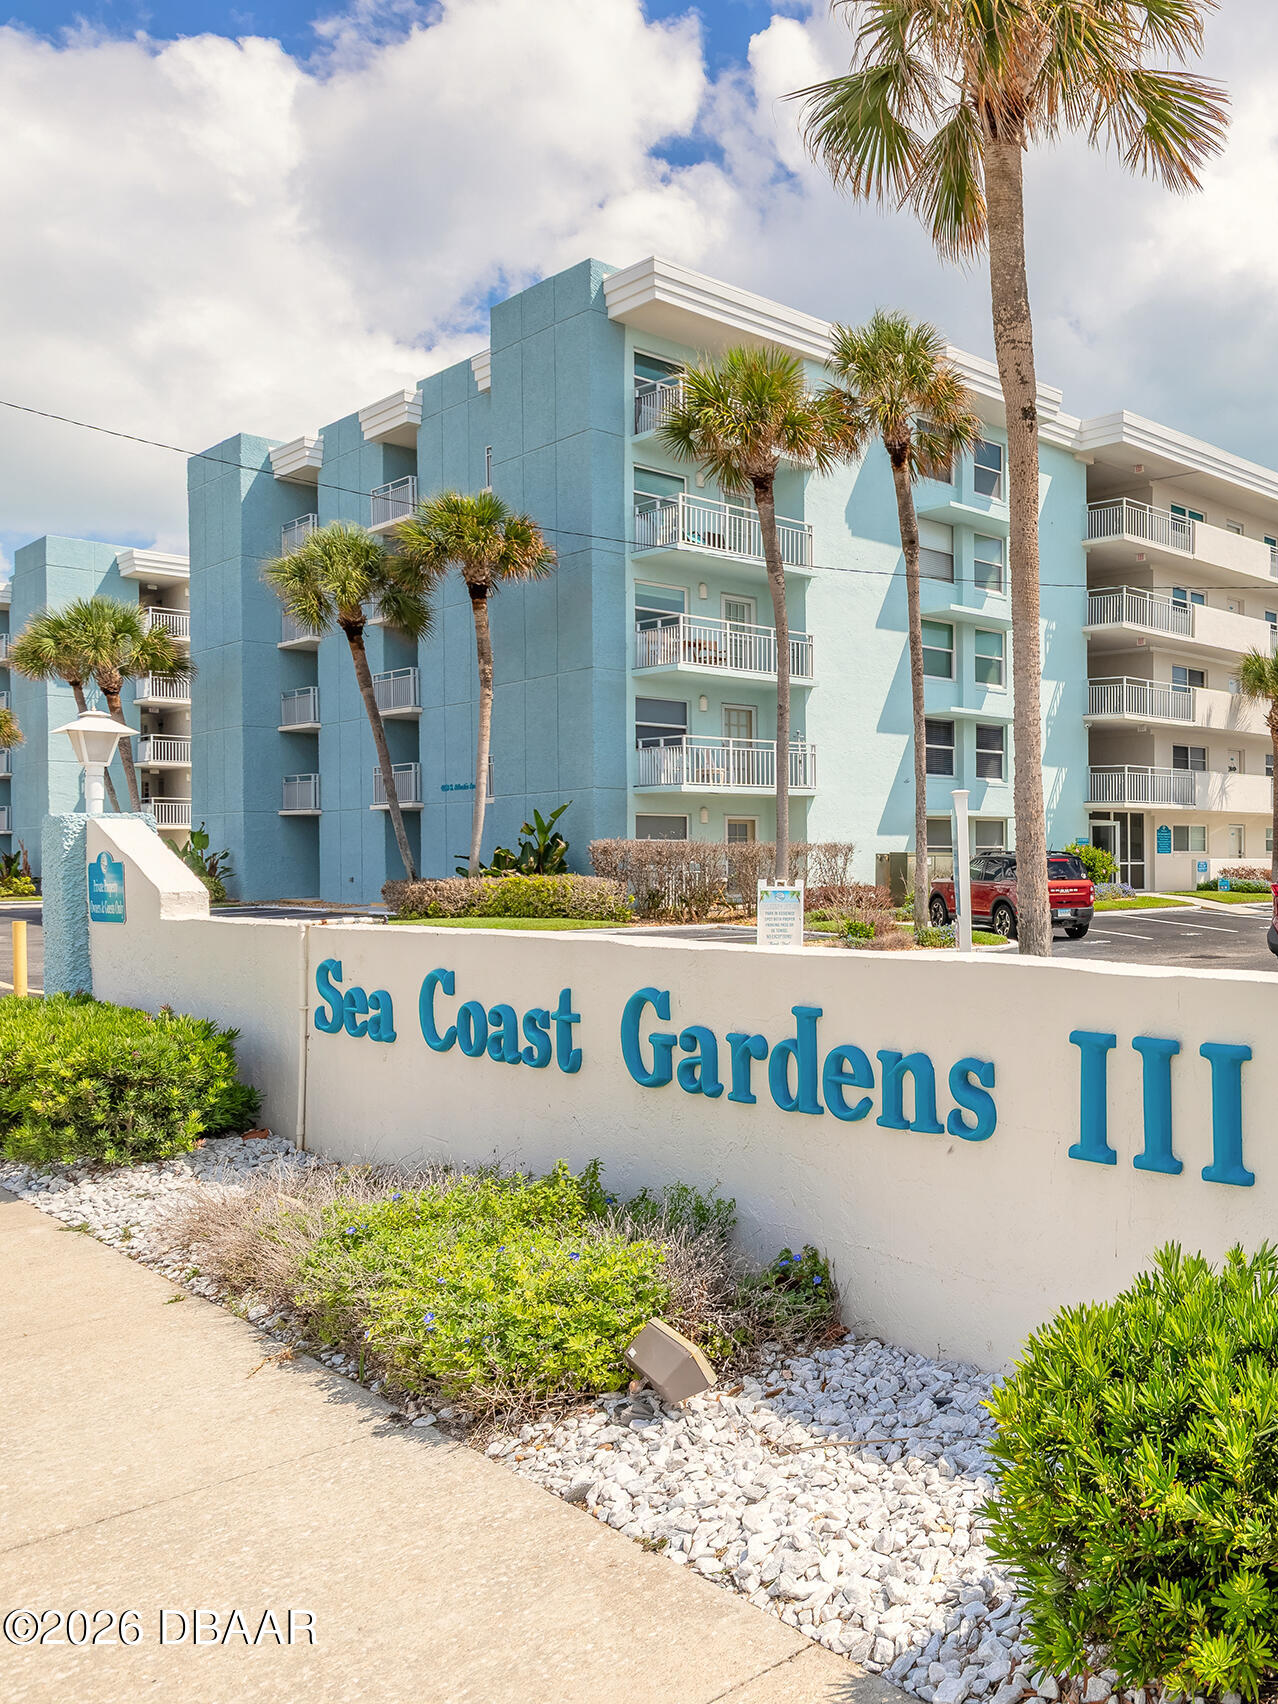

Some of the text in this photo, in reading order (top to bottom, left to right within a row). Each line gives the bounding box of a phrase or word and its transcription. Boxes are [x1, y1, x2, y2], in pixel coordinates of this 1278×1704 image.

[315, 960, 1254, 1186] Sea Coast Gardens III
